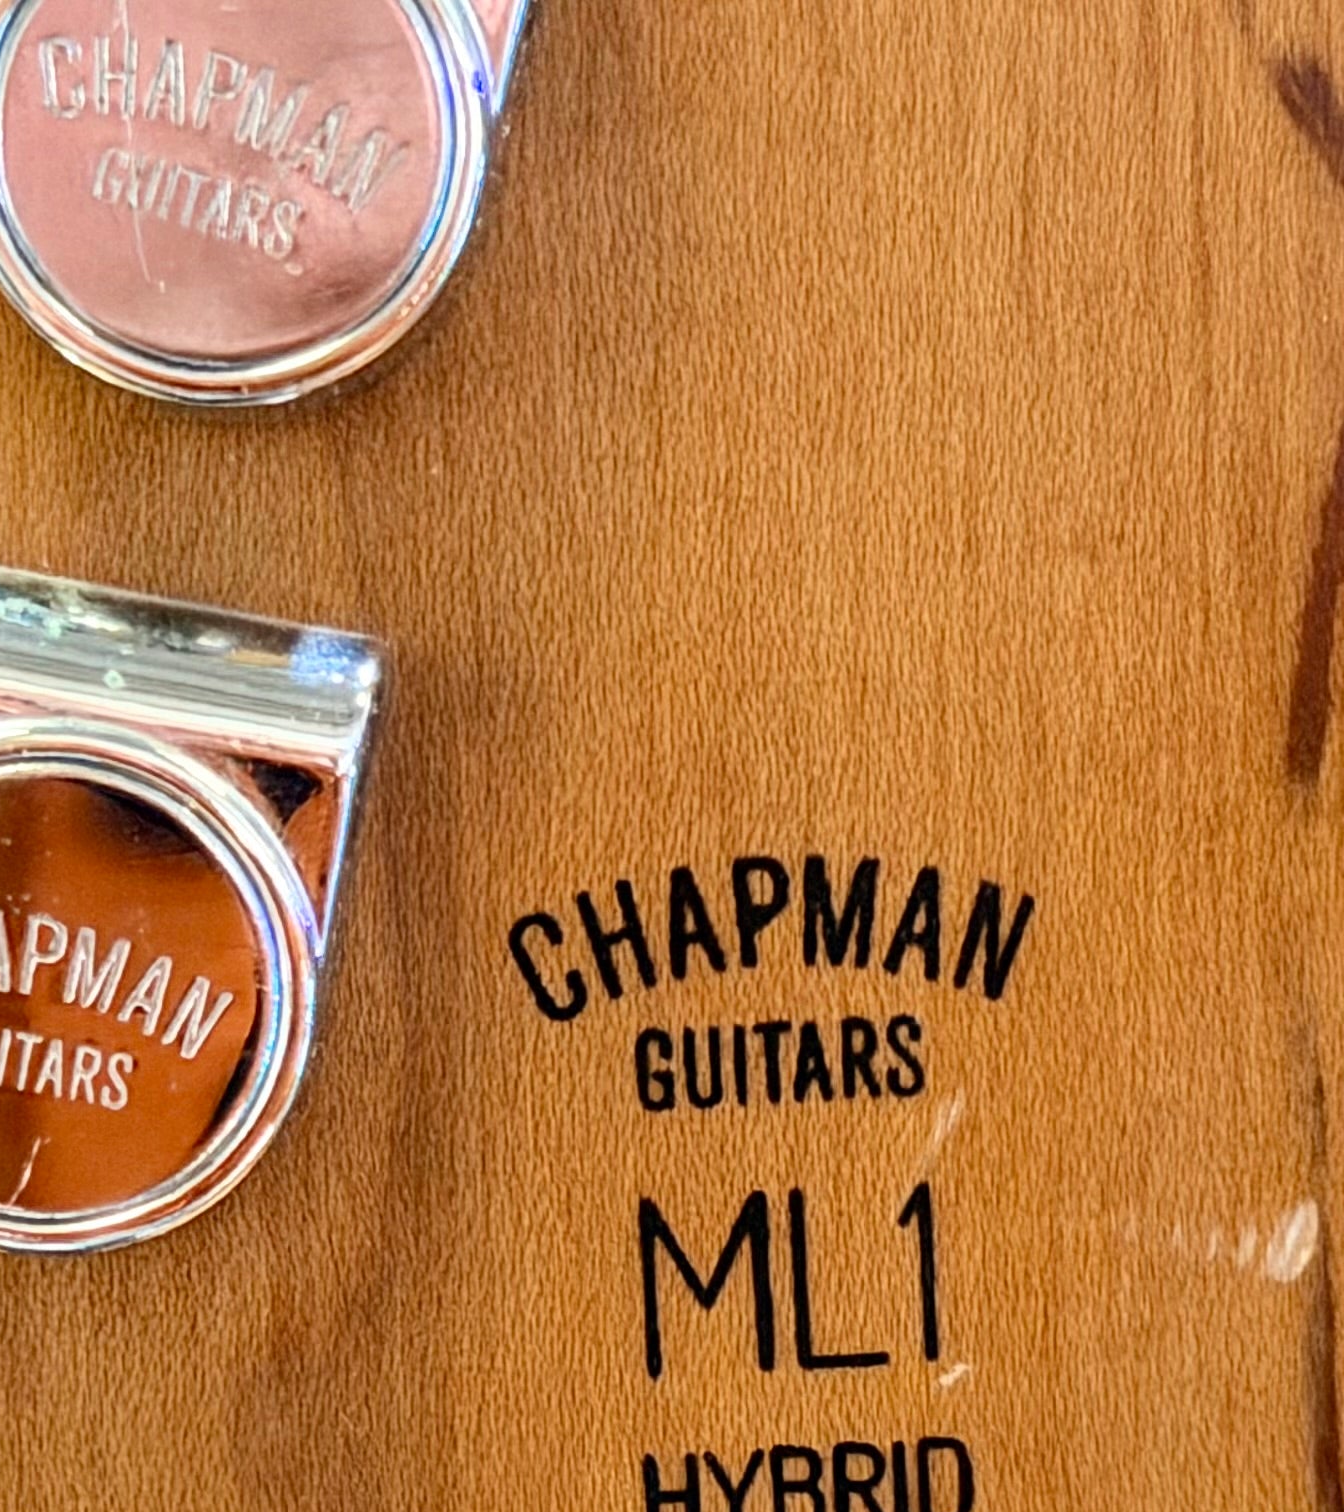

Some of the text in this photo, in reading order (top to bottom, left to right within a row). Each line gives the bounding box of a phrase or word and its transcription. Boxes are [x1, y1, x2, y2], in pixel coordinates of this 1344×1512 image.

[37, 36, 411, 215] CHAPMAN
[92, 147, 303, 261] GUITARS
[509, 853, 1035, 1021] CHAPMAN
[635, 1014, 926, 1112] GUITARS
[638, 1180, 939, 1381] ML1
